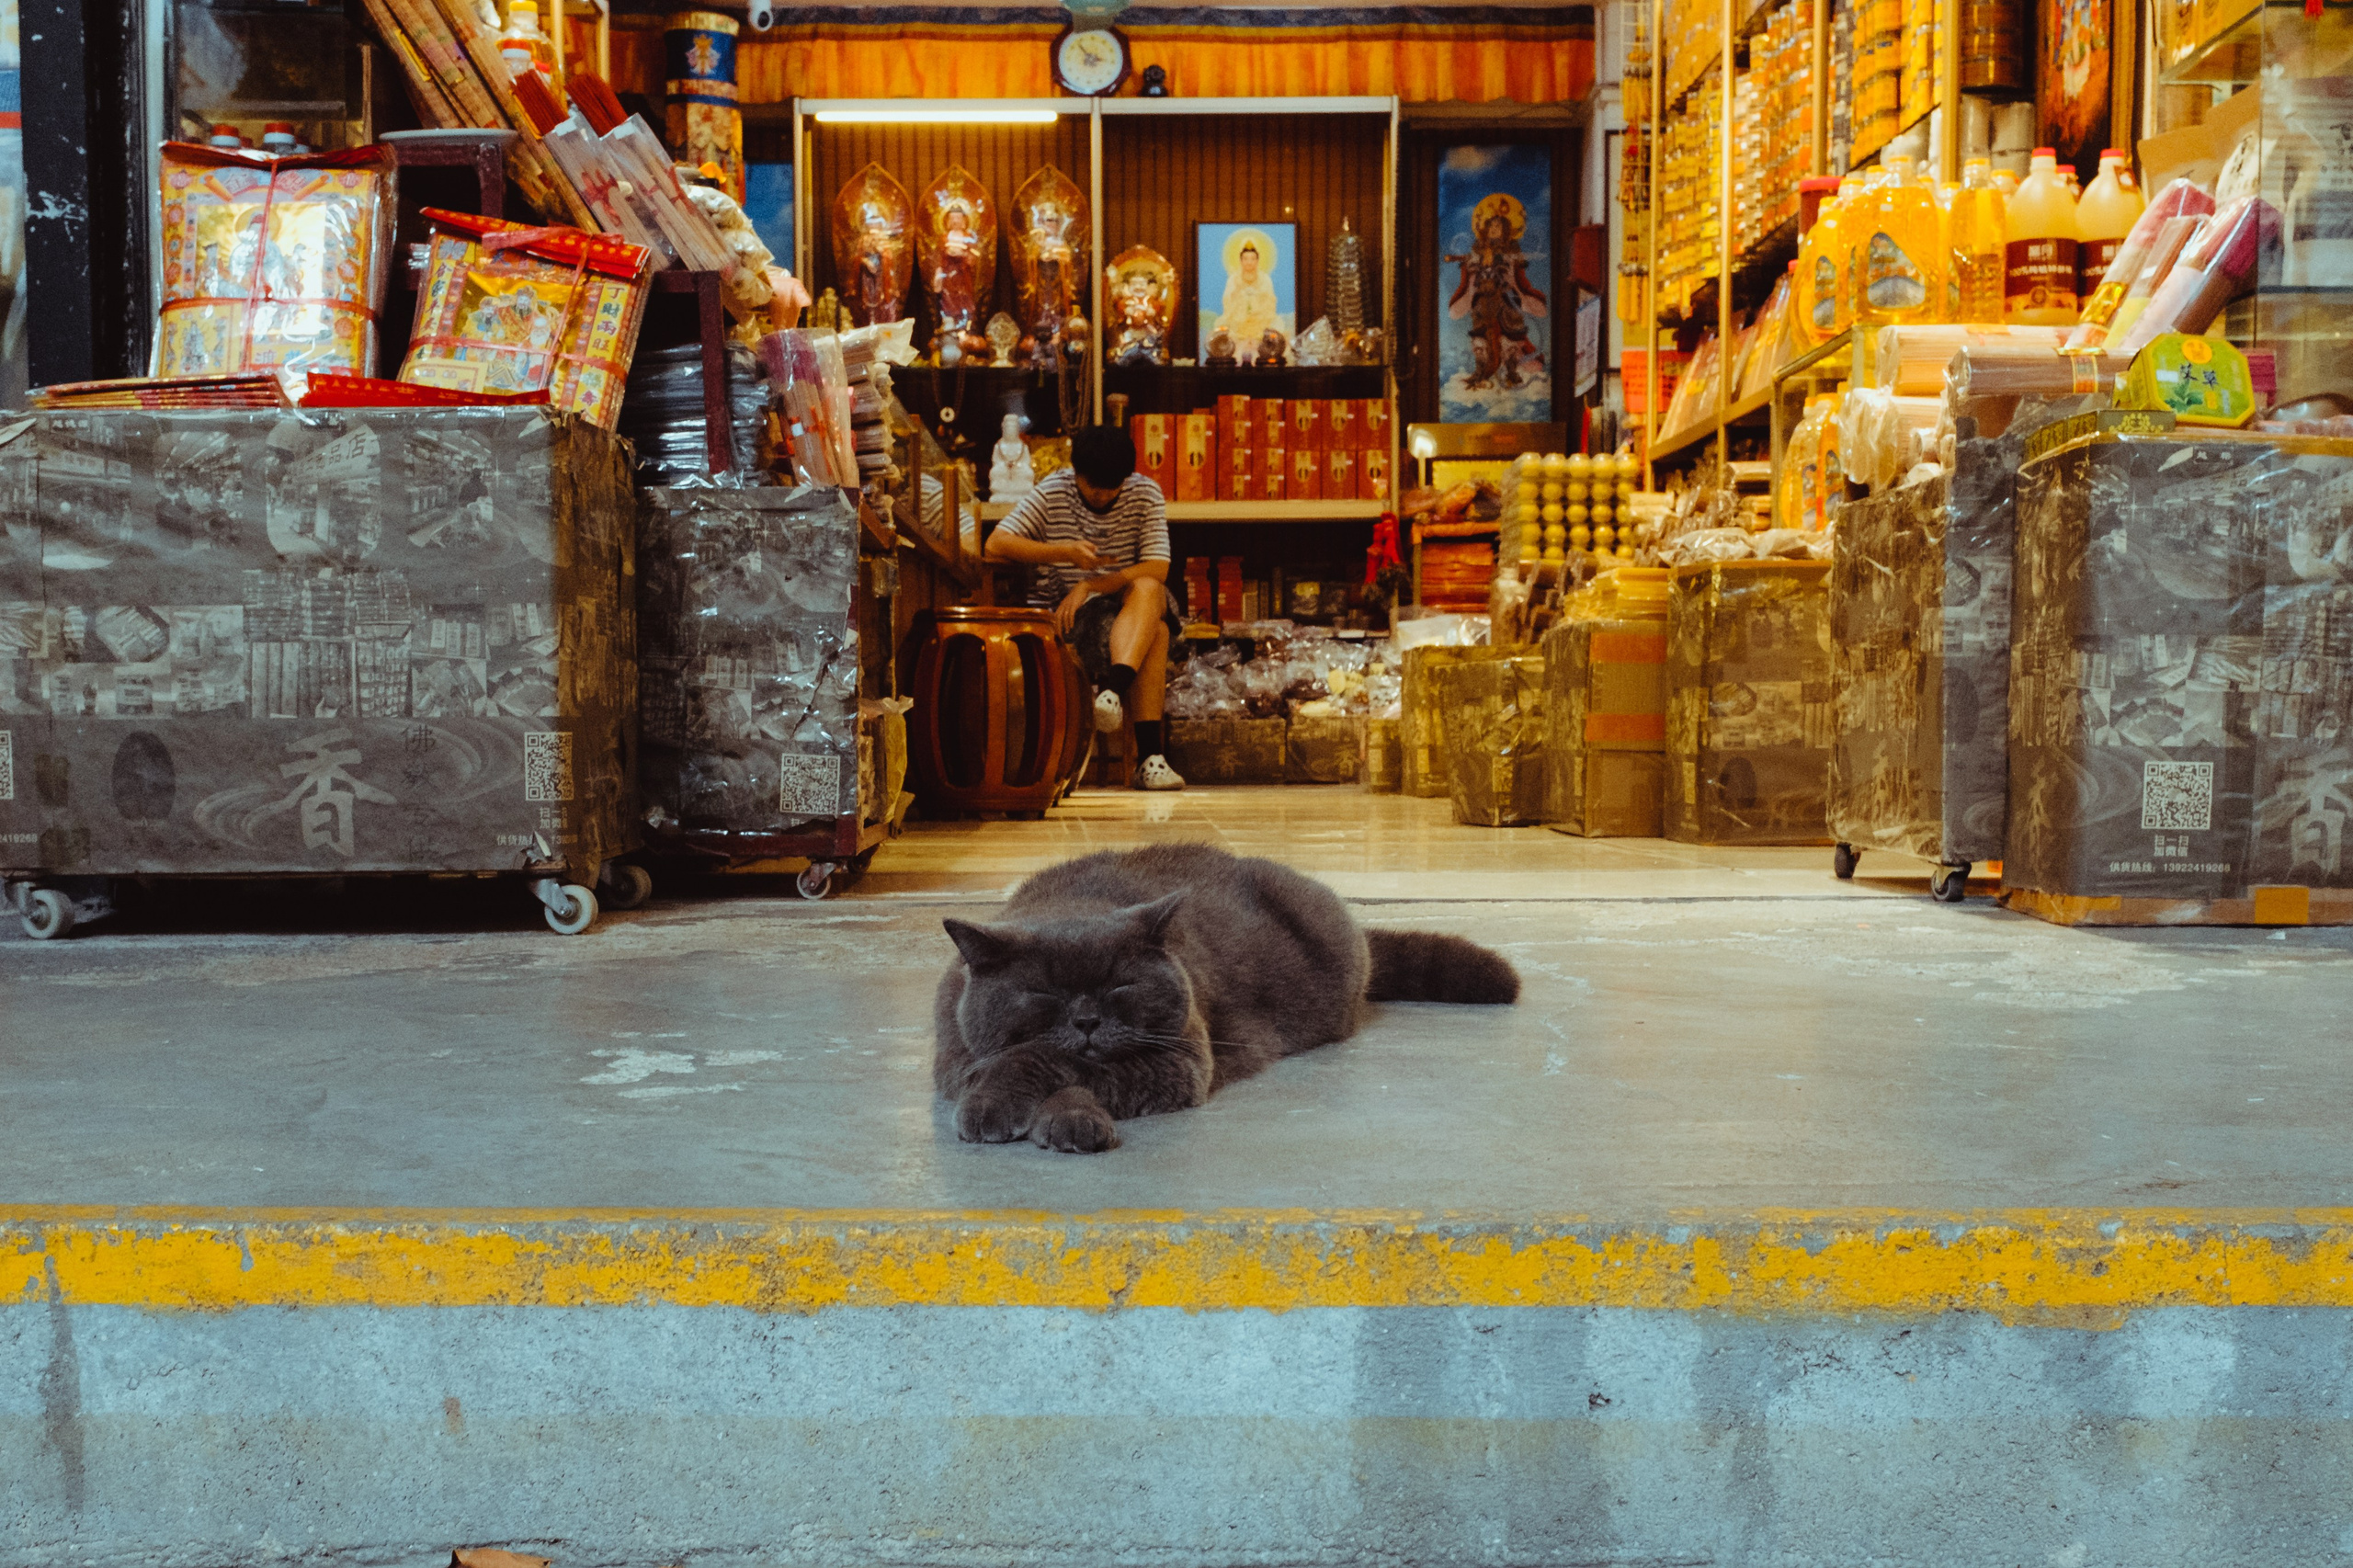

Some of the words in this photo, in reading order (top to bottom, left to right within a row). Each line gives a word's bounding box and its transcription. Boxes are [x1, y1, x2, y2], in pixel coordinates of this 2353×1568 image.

[261, 728, 398, 857] 香
[2154, 835, 2188, 846] 扫一扫
